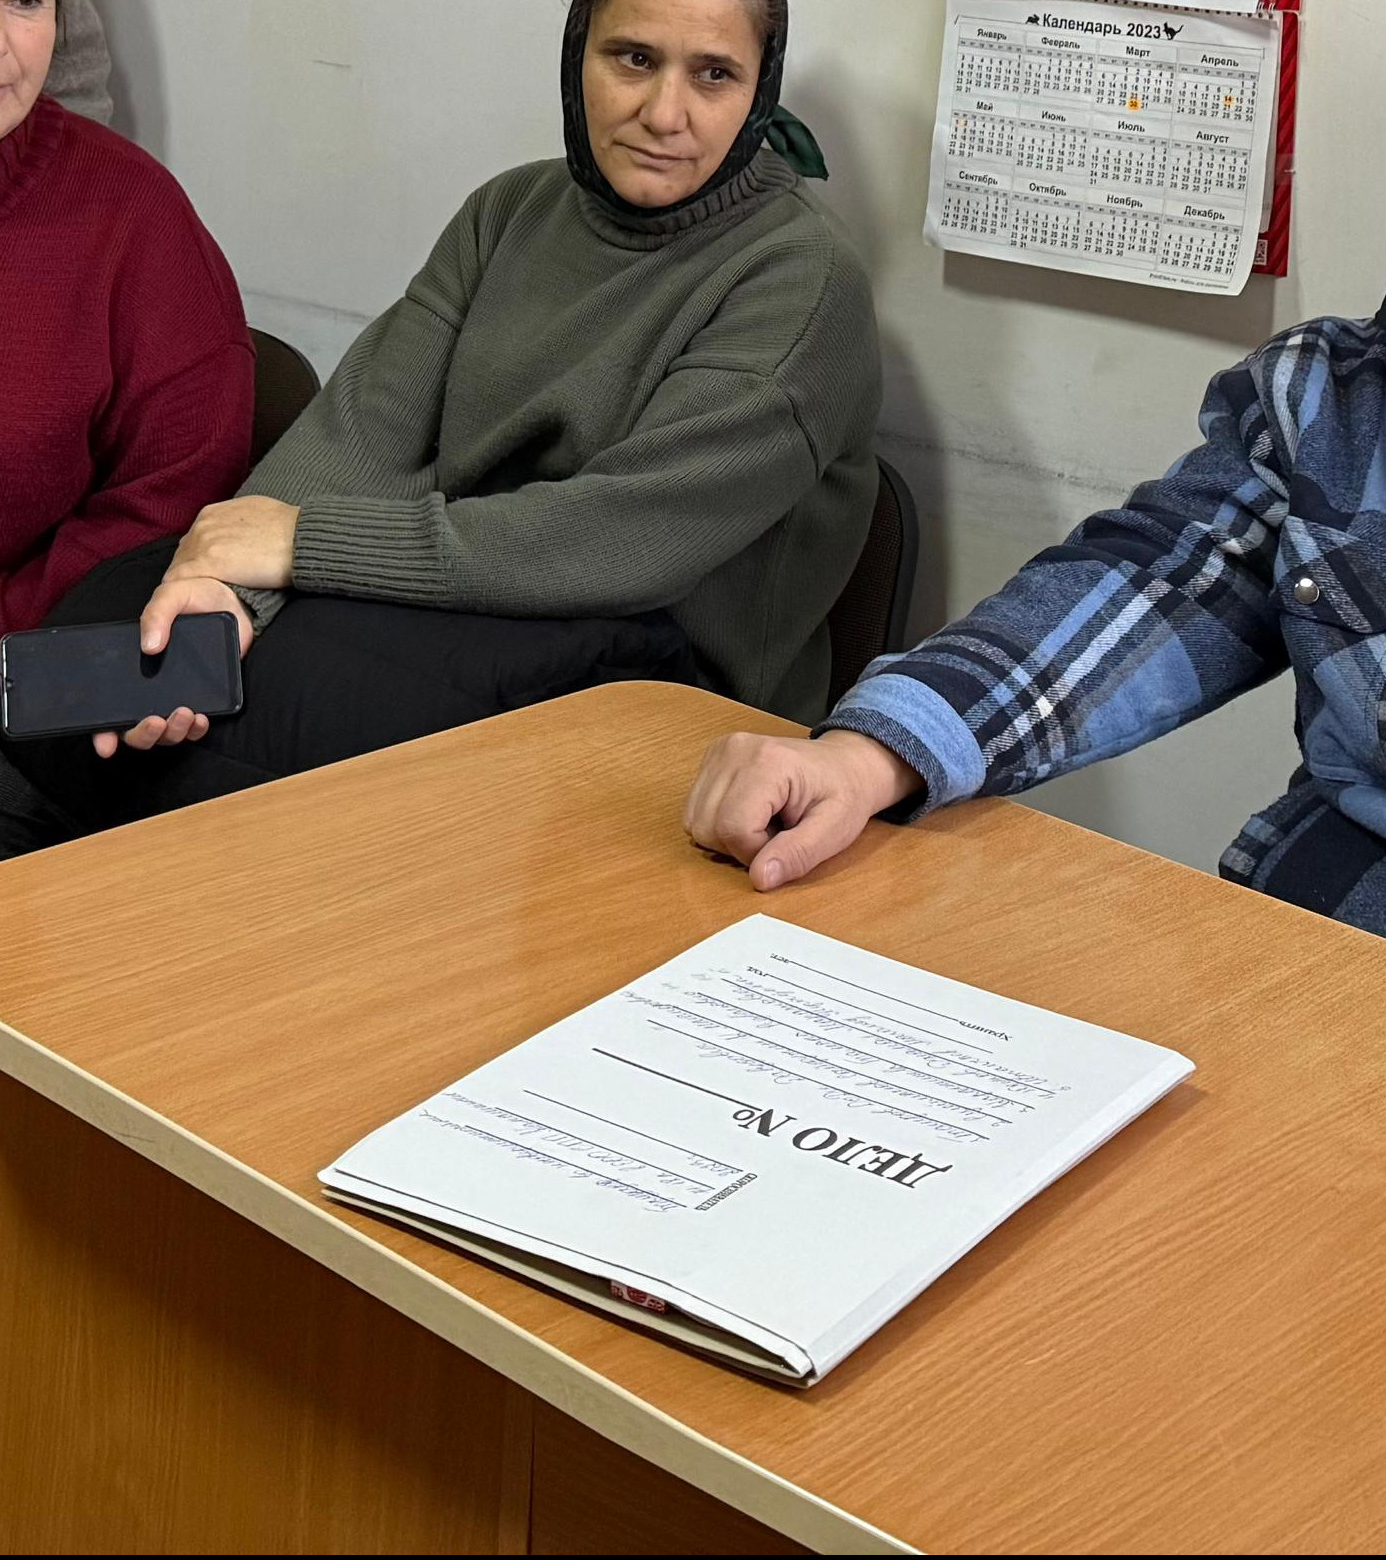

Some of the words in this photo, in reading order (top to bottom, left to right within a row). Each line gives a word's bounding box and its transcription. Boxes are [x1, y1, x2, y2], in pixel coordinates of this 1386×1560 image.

[1042, 13, 1121, 37] Календарь
[1126, 23, 1161, 39] 2023
[977, 29, 1007, 40] Январь
[1041, 37, 1080, 49] Февраль
[1126, 46, 1151, 58] Март
[1201, 54, 1239, 67] Апрель
[977, 101, 994, 111] Май
[1042, 111, 1066, 122] Июнь
[1118, 121, 1145, 132] Июль
[1196, 131, 1229, 144] Август
[959, 171, 998, 186] Сентябрь
[1029, 183, 1066, 197] Октябрь
[1107, 194, 1143, 208] Ноябрь
[1184, 205, 1225, 220] Декабрь
[732, 1108, 797, 1137] №
[792, 1127, 953, 1189] ДЕЛО
